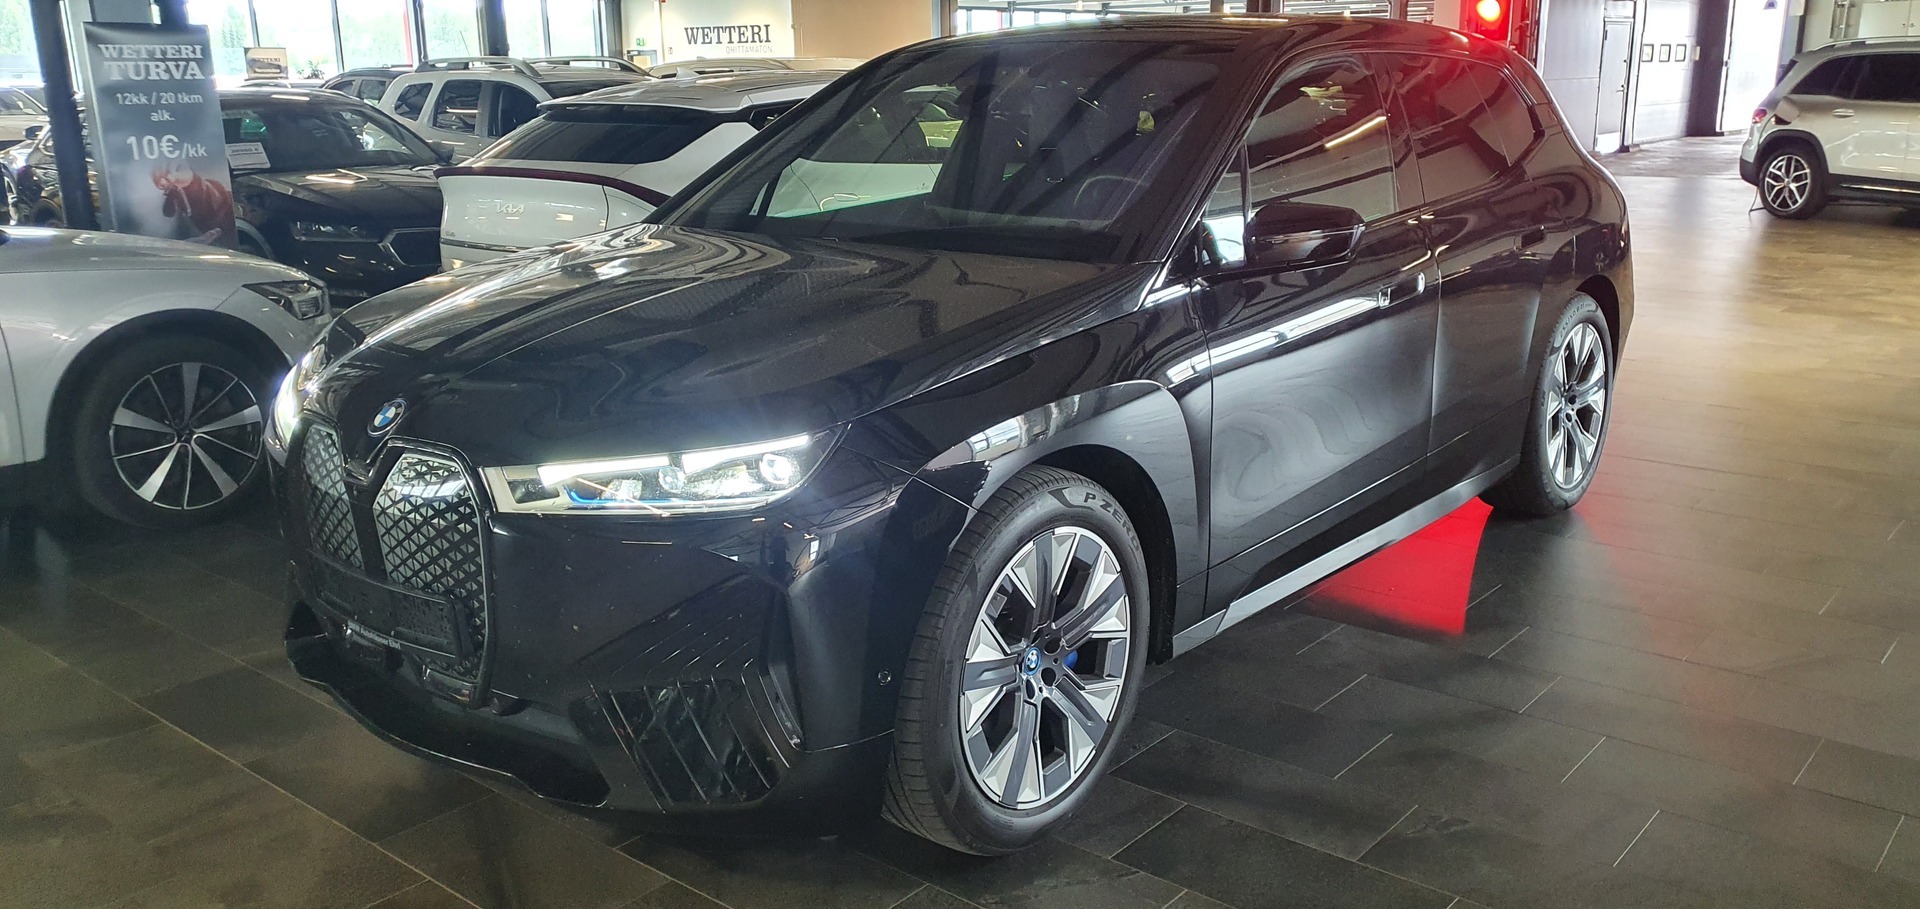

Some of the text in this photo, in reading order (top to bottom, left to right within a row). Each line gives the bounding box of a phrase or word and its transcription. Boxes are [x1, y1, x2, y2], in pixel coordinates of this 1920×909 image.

[684, 24, 771, 45] WETTERI
[97, 44, 203, 59] WETTERI
[104, 61, 205, 81] TURVA
[115, 92, 149, 105] 12kk
[160, 92, 176, 105] 20
[178, 91, 204, 104] tkm
[150, 110, 176, 122] alk.
[1083, 492, 1140, 552] P ZERO
